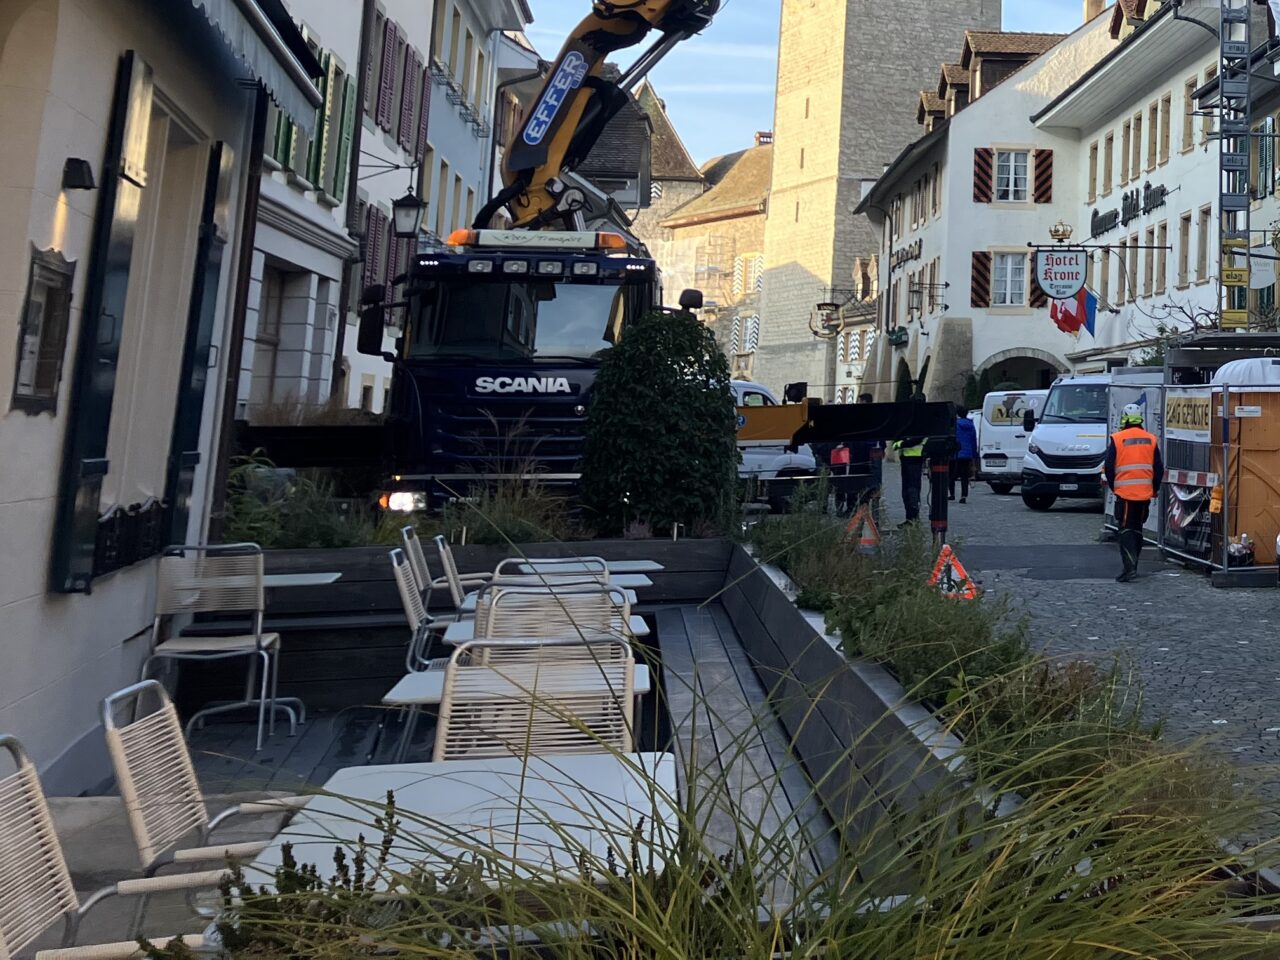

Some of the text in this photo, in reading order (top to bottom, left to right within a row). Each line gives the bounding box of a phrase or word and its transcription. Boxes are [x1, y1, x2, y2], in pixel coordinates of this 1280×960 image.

[527, 54, 581, 139] EFFER
[1044, 253, 1080, 268] Hotel
[1043, 268, 1081, 282] Krone
[1225, 271, 1243, 282] elag
[474, 376, 572, 393] SCANIA
